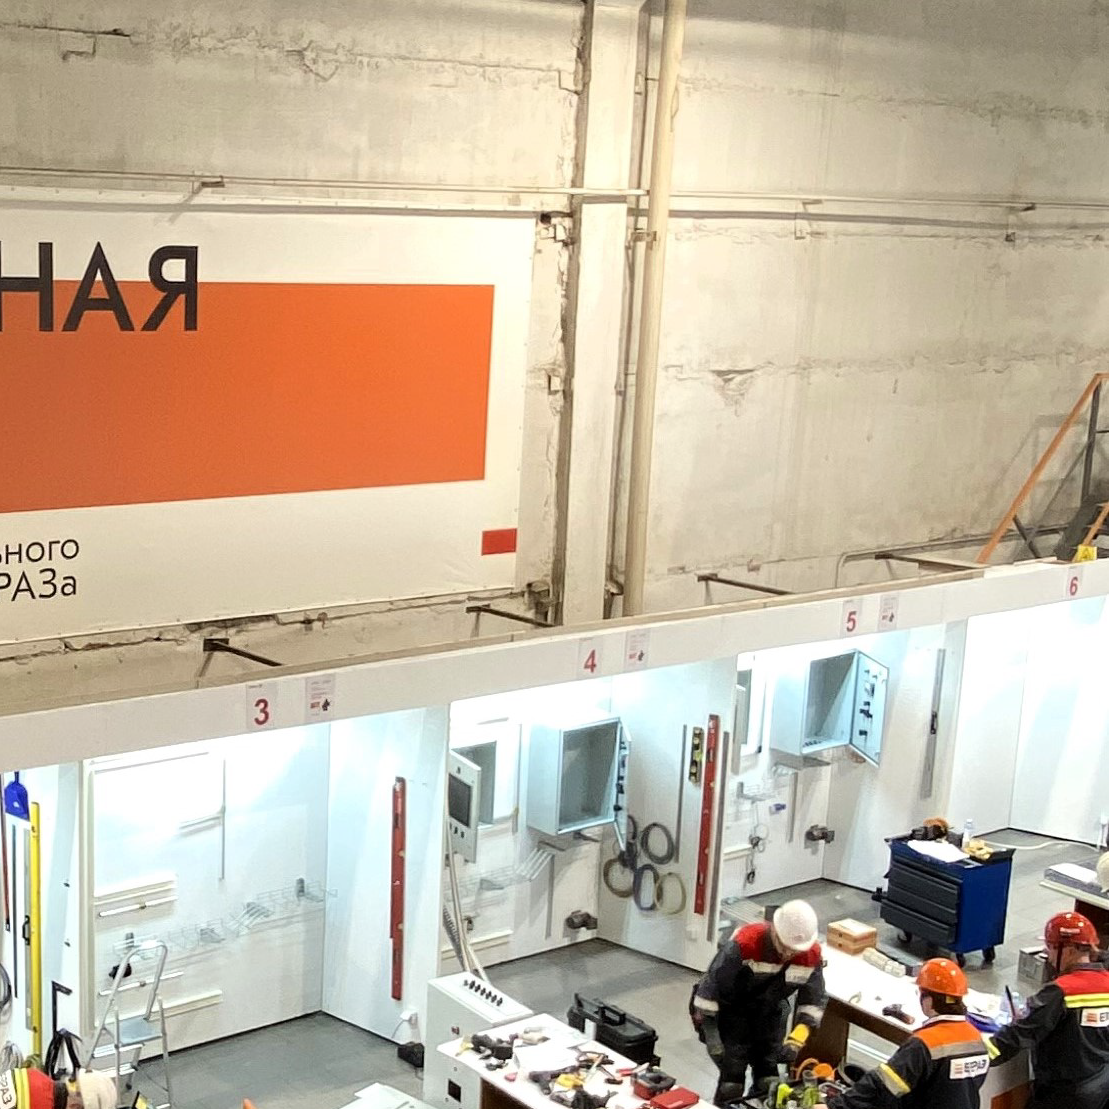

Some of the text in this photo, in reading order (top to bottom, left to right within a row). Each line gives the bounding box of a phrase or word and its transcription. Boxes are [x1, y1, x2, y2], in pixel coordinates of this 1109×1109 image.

[1069, 576, 1079, 597] 6
[846, 611, 857, 632] 5
[583, 649, 597, 673] 4
[254, 698, 270, 726] 3
